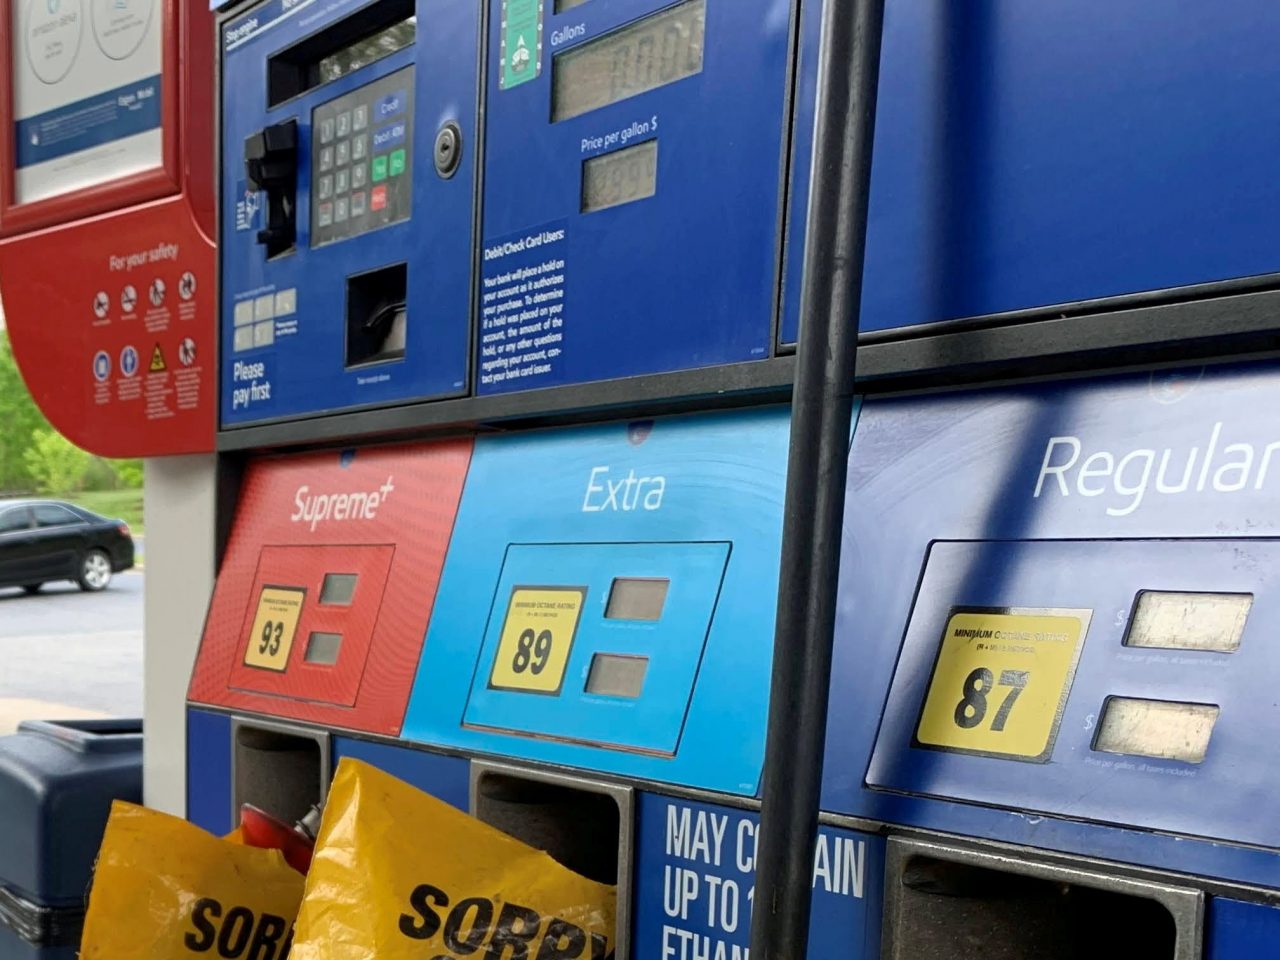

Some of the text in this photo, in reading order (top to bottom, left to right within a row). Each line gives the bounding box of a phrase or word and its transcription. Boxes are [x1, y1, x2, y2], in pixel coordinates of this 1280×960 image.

[551, 23, 586, 46] Gallons
[581, 115, 658, 153] Price per gallon $
[526, 232, 542, 249] Card
[497, 272, 511, 285] bank
[522, 266, 537, 281] place
[542, 260, 556, 273] hold
[556, 260, 565, 269] on
[483, 292, 496, 304] your
[497, 285, 519, 299] account
[520, 283, 527, 293] as
[533, 273, 564, 289] authorizes
[483, 306, 496, 318] your
[524, 294, 532, 305] To
[533, 287, 564, 304] determine
[493, 315, 507, 327] hold
[507, 314, 519, 323] was
[520, 306, 539, 324] placed
[539, 307, 548, 316] on
[549, 303, 563, 317] your
[507, 326, 518, 338] the
[519, 321, 542, 335] amount
[543, 317, 552, 330] of
[552, 316, 563, 328] the
[497, 345, 505, 354] or
[505, 343, 516, 353] any
[517, 338, 533, 350] other
[534, 332, 562, 348] questions
[234, 360, 265, 382] Please
[482, 357, 509, 372] regarding
[509, 355, 522, 367] your
[493, 372, 506, 384] your
[506, 368, 520, 379] bank
[520, 364, 533, 376] card
[233, 380, 271, 410] pay first
[1033, 421, 1280, 516] Regular
[582, 465, 666, 512] Extra
[259, 620, 285, 657] 93
[954, 628, 993, 640] MINIMUM
[512, 628, 553, 676] 89
[954, 667, 1031, 733] 87
[1083, 714, 1095, 731] $
[666, 804, 729, 867] MAY
[664, 865, 699, 920] UP
[705, 874, 739, 933] TO
